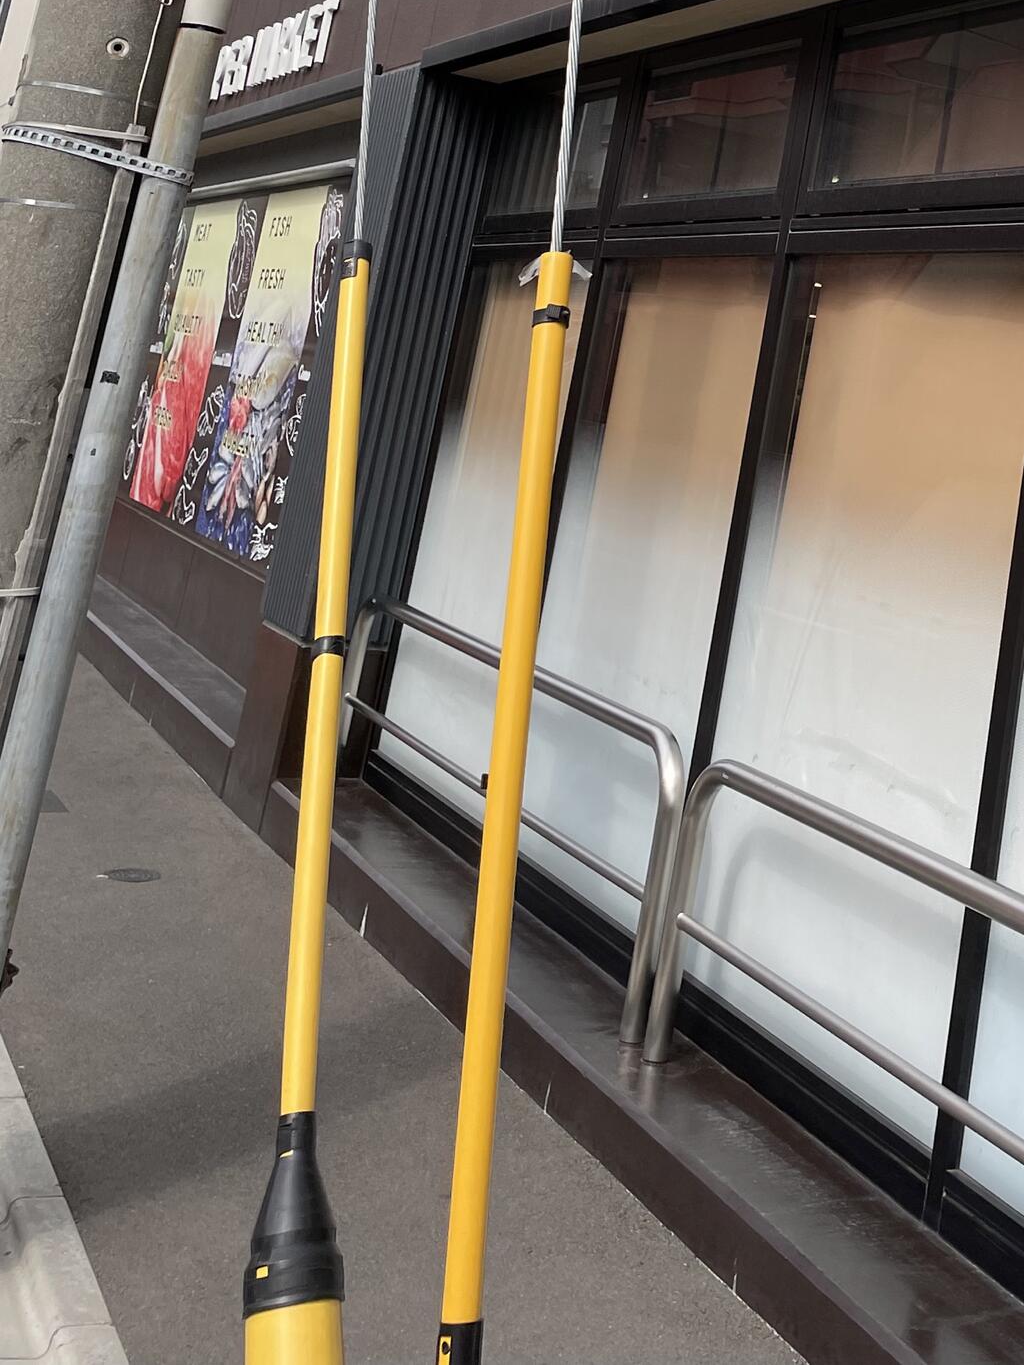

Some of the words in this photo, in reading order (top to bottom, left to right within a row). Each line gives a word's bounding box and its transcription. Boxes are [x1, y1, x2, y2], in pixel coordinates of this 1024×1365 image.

[193, 223, 212, 242] MEAT
[269, 216, 293, 238] FISH
[184, 268, 206, 288] TASTY
[257, 268, 287, 290] FRESH
[246, 321, 285, 346] HEALTHY
